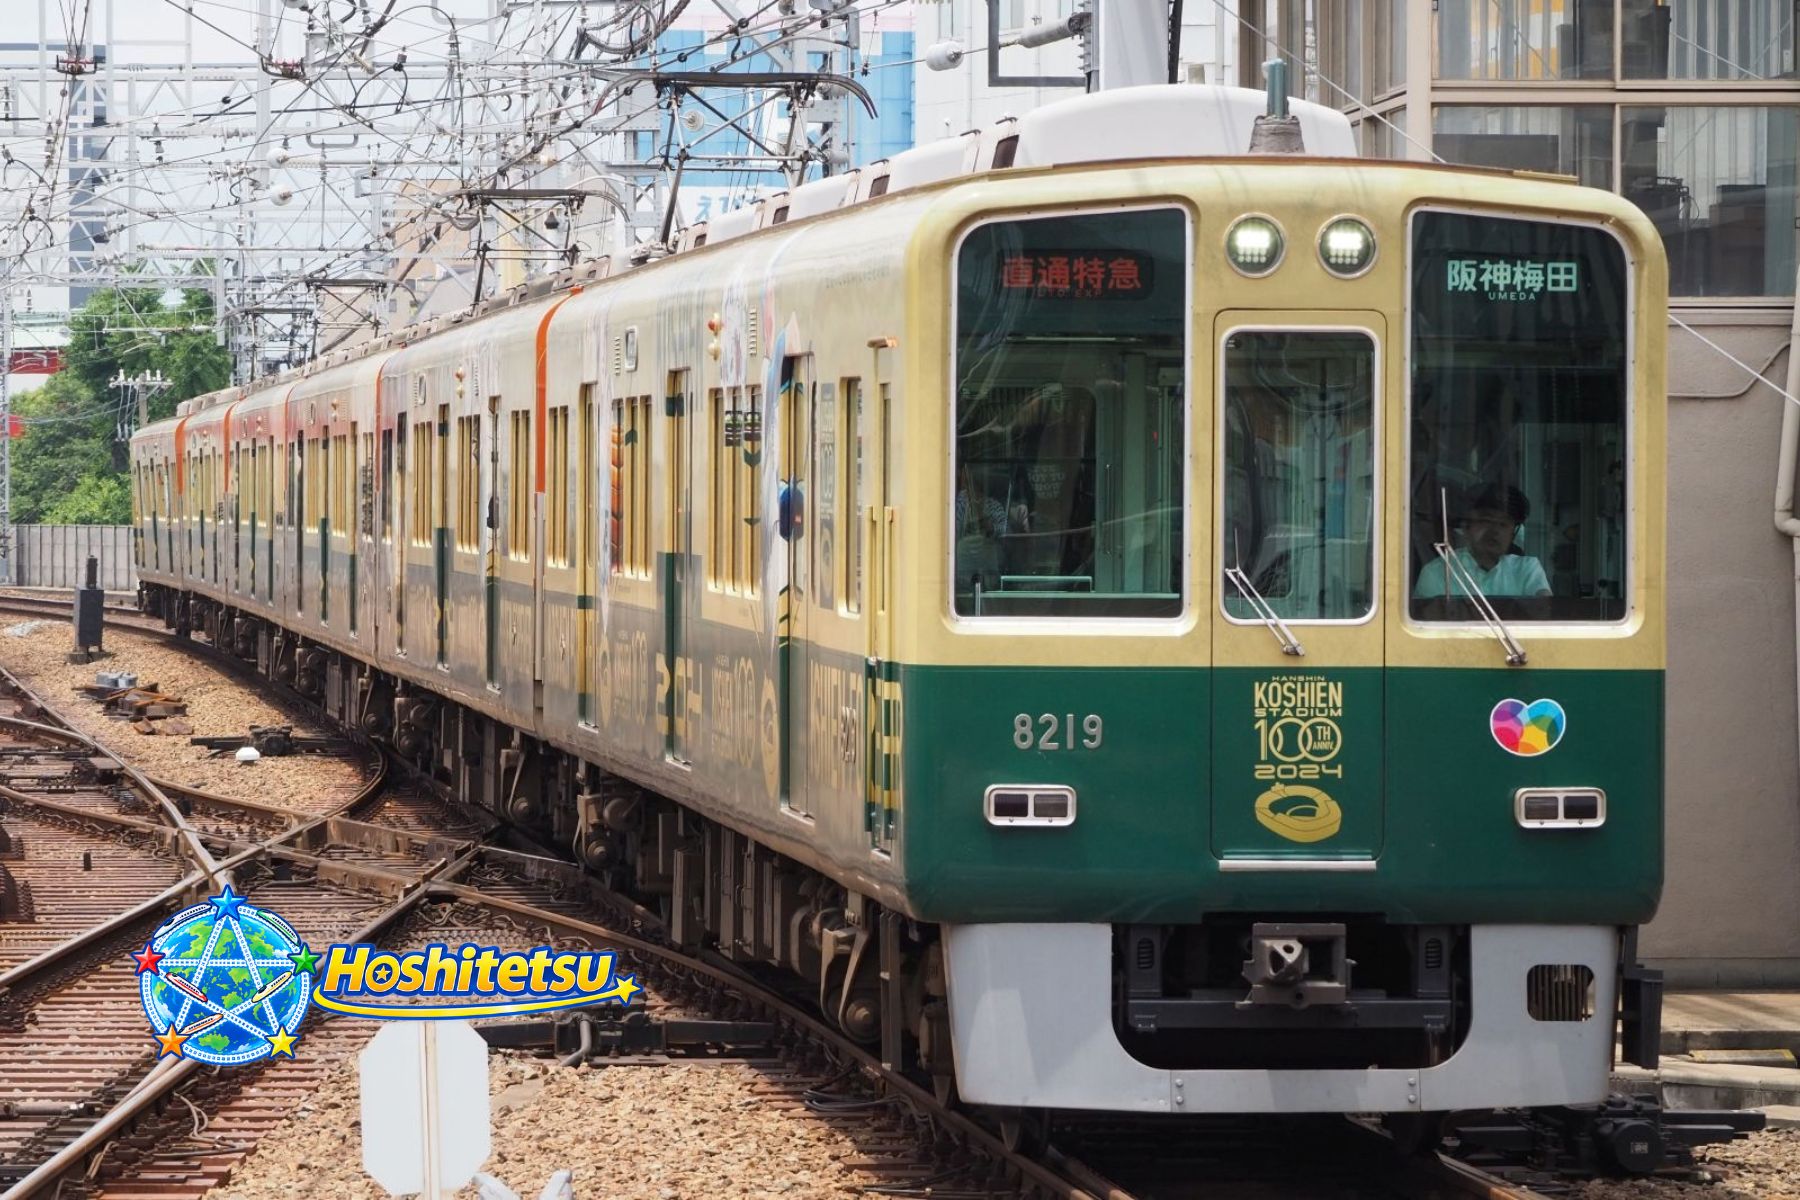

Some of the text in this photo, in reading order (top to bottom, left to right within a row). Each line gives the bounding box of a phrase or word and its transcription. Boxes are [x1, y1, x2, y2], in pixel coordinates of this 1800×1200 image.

[1002, 257, 1142, 289] 直通特急
[1447, 260, 1577, 292] 阪神梅田
[1488, 291, 1536, 301] UMEDA
[1254, 681, 1342, 708] KOSHIEN
[1254, 707, 1342, 717] STADIUM
[1013, 713, 1103, 750] 8219
[1254, 717, 1342, 762] 100 TH
[1254, 763, 1342, 779] 2024
